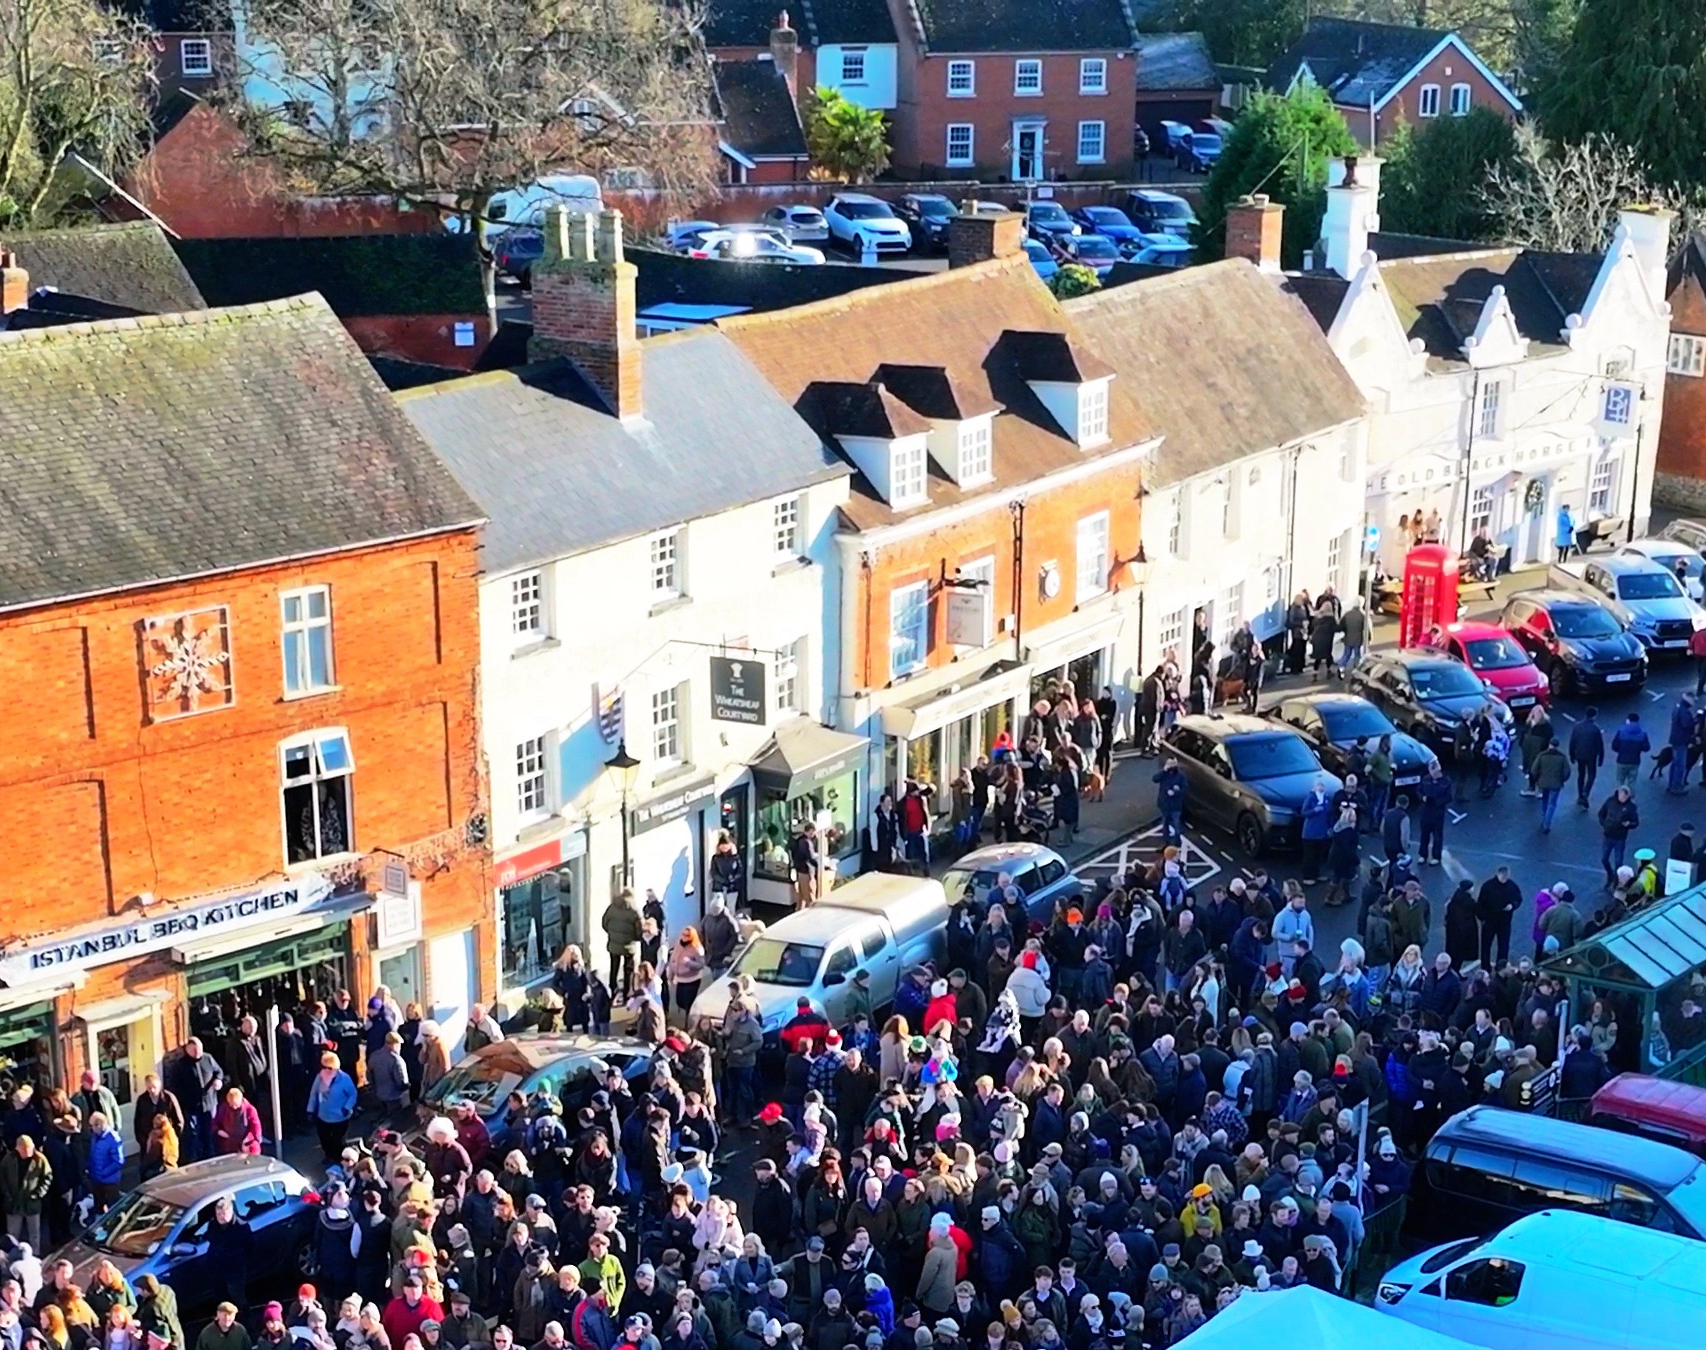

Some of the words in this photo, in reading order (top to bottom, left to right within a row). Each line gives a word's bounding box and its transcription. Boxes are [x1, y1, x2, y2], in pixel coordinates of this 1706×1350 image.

[1365, 476, 1388, 491] HE
[1398, 468, 1434, 485] OLD
[1515, 440, 1576, 462] HORSE
[29, 928, 147, 970] ISTANBUL
[152, 914, 199, 940] BBQ
[203, 888, 300, 926] KITCHEN
